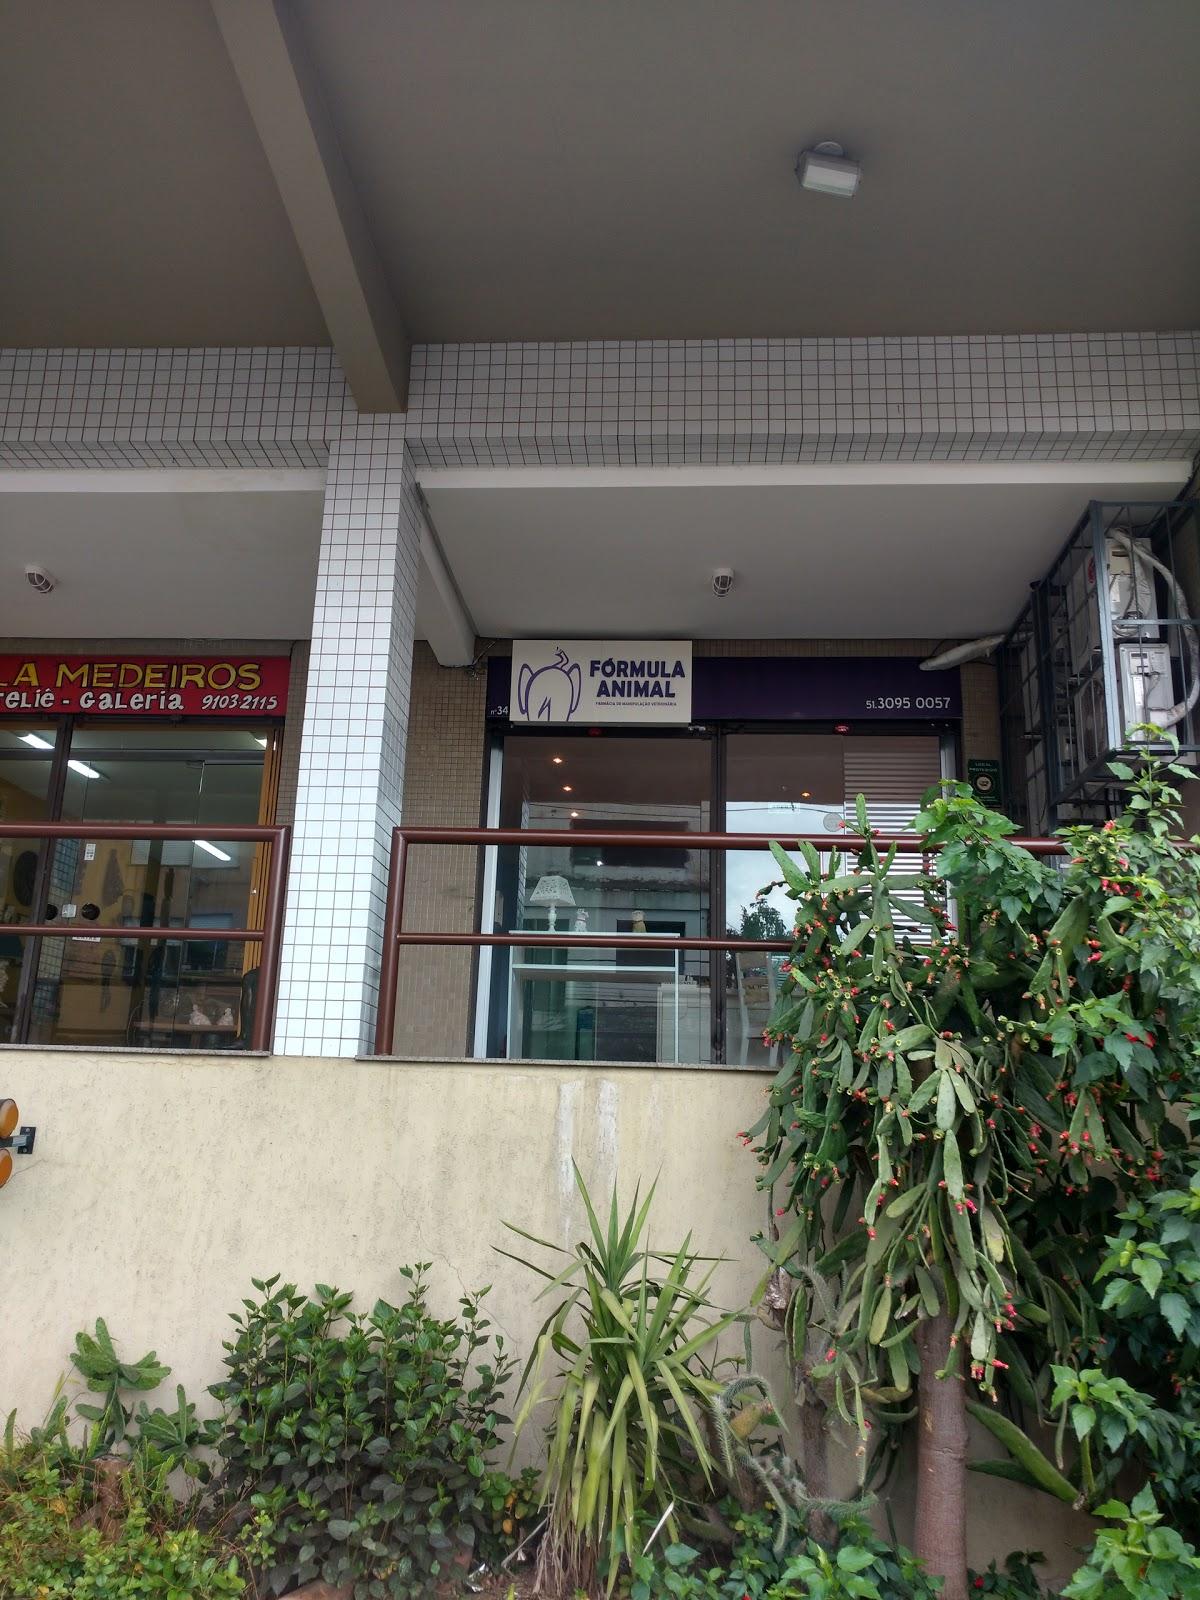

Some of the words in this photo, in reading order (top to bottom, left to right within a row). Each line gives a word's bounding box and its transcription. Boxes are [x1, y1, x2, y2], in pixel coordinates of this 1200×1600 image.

[0, 662, 39, 687] A
[55, 663, 262, 691] MEDEIROS
[589, 657, 686, 678] FÓRMULA
[596, 680, 676, 698] ANIMAL
[915, 697, 951, 709] 0057
